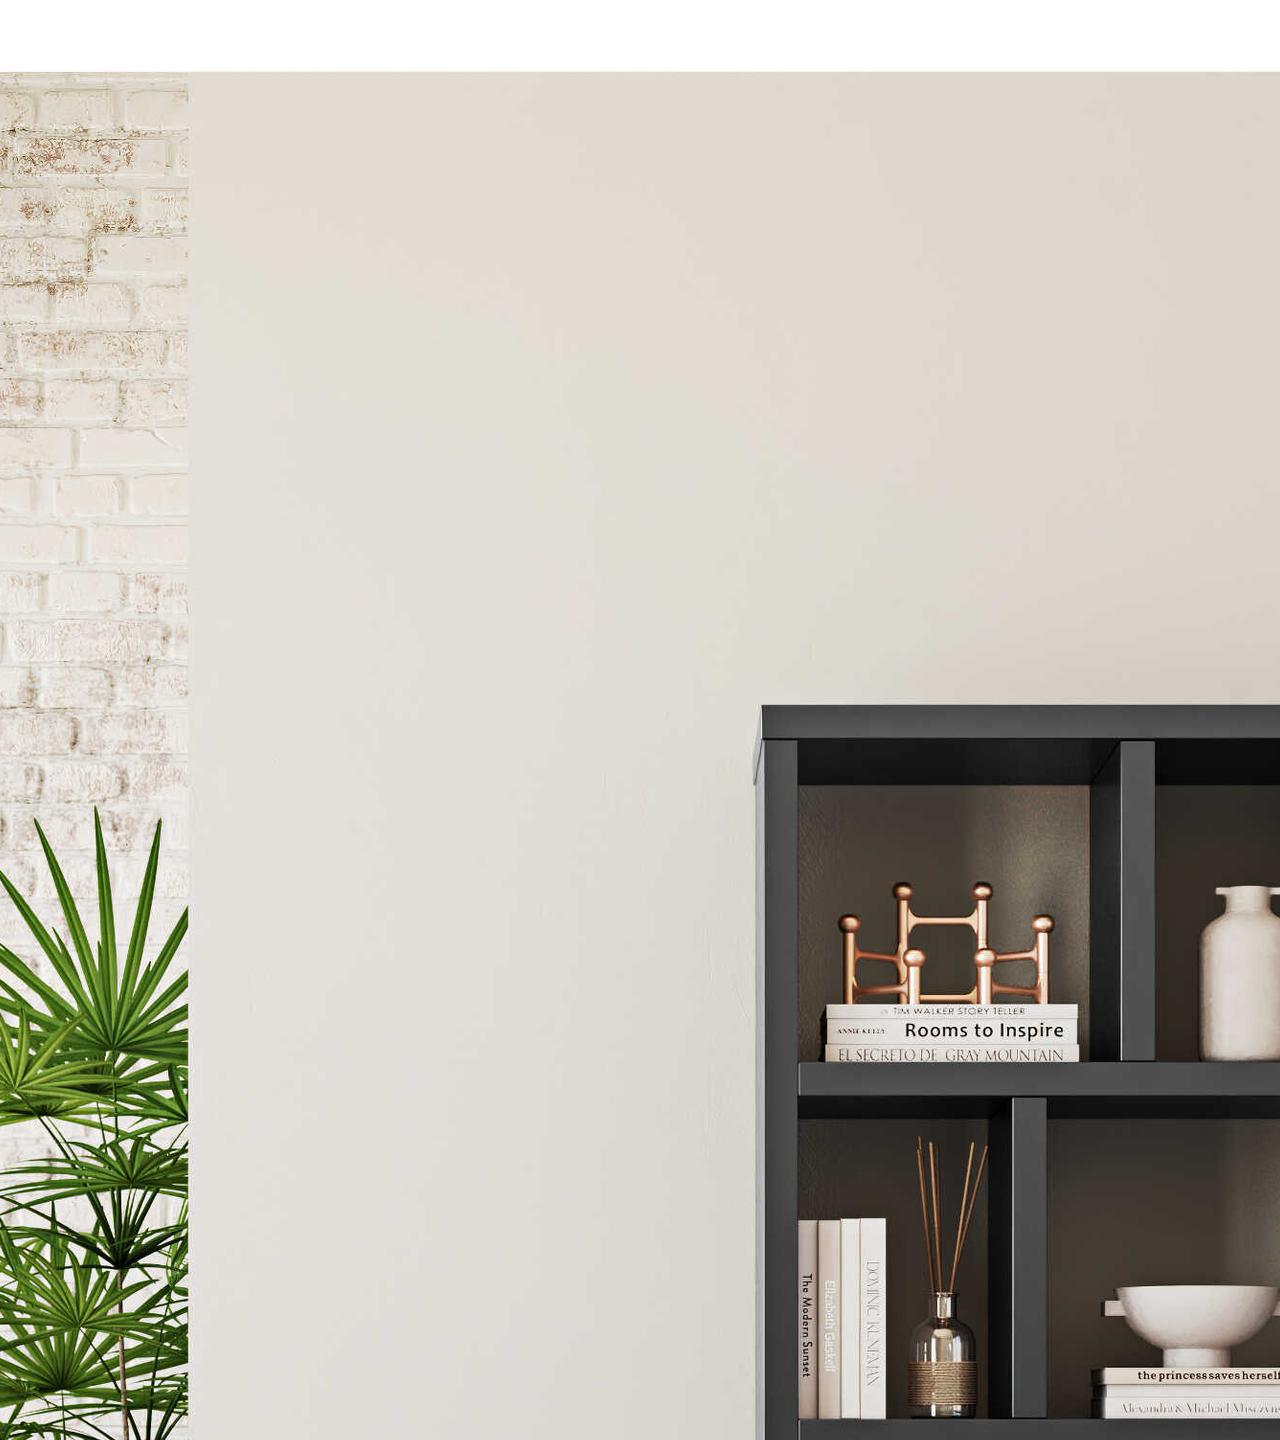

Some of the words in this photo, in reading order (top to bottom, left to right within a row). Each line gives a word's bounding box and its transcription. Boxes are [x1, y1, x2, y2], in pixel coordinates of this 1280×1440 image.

[905, 1023, 968, 1038] Rooms
[975, 1023, 993, 1037] to
[1001, 1022, 1064, 1042] Inspire
[839, 1048, 851, 1061] EL
[855, 1048, 917, 1061] SECRETO
[920, 1048, 936, 1061] DE
[945, 1048, 981, 1061] GRAY
[986, 1048, 1064, 1061] MOUNTAIN
[802, 1273, 813, 1293] The
[802, 1297, 813, 1338] Modern
[802, 1341, 813, 1378] Sunset
[1138, 1370, 1157, 1380] the
[1159, 1370, 1207, 1382] princess
[1208, 1372, 1240, 1380] saves
[1175, 1403, 1184, 1413] &
